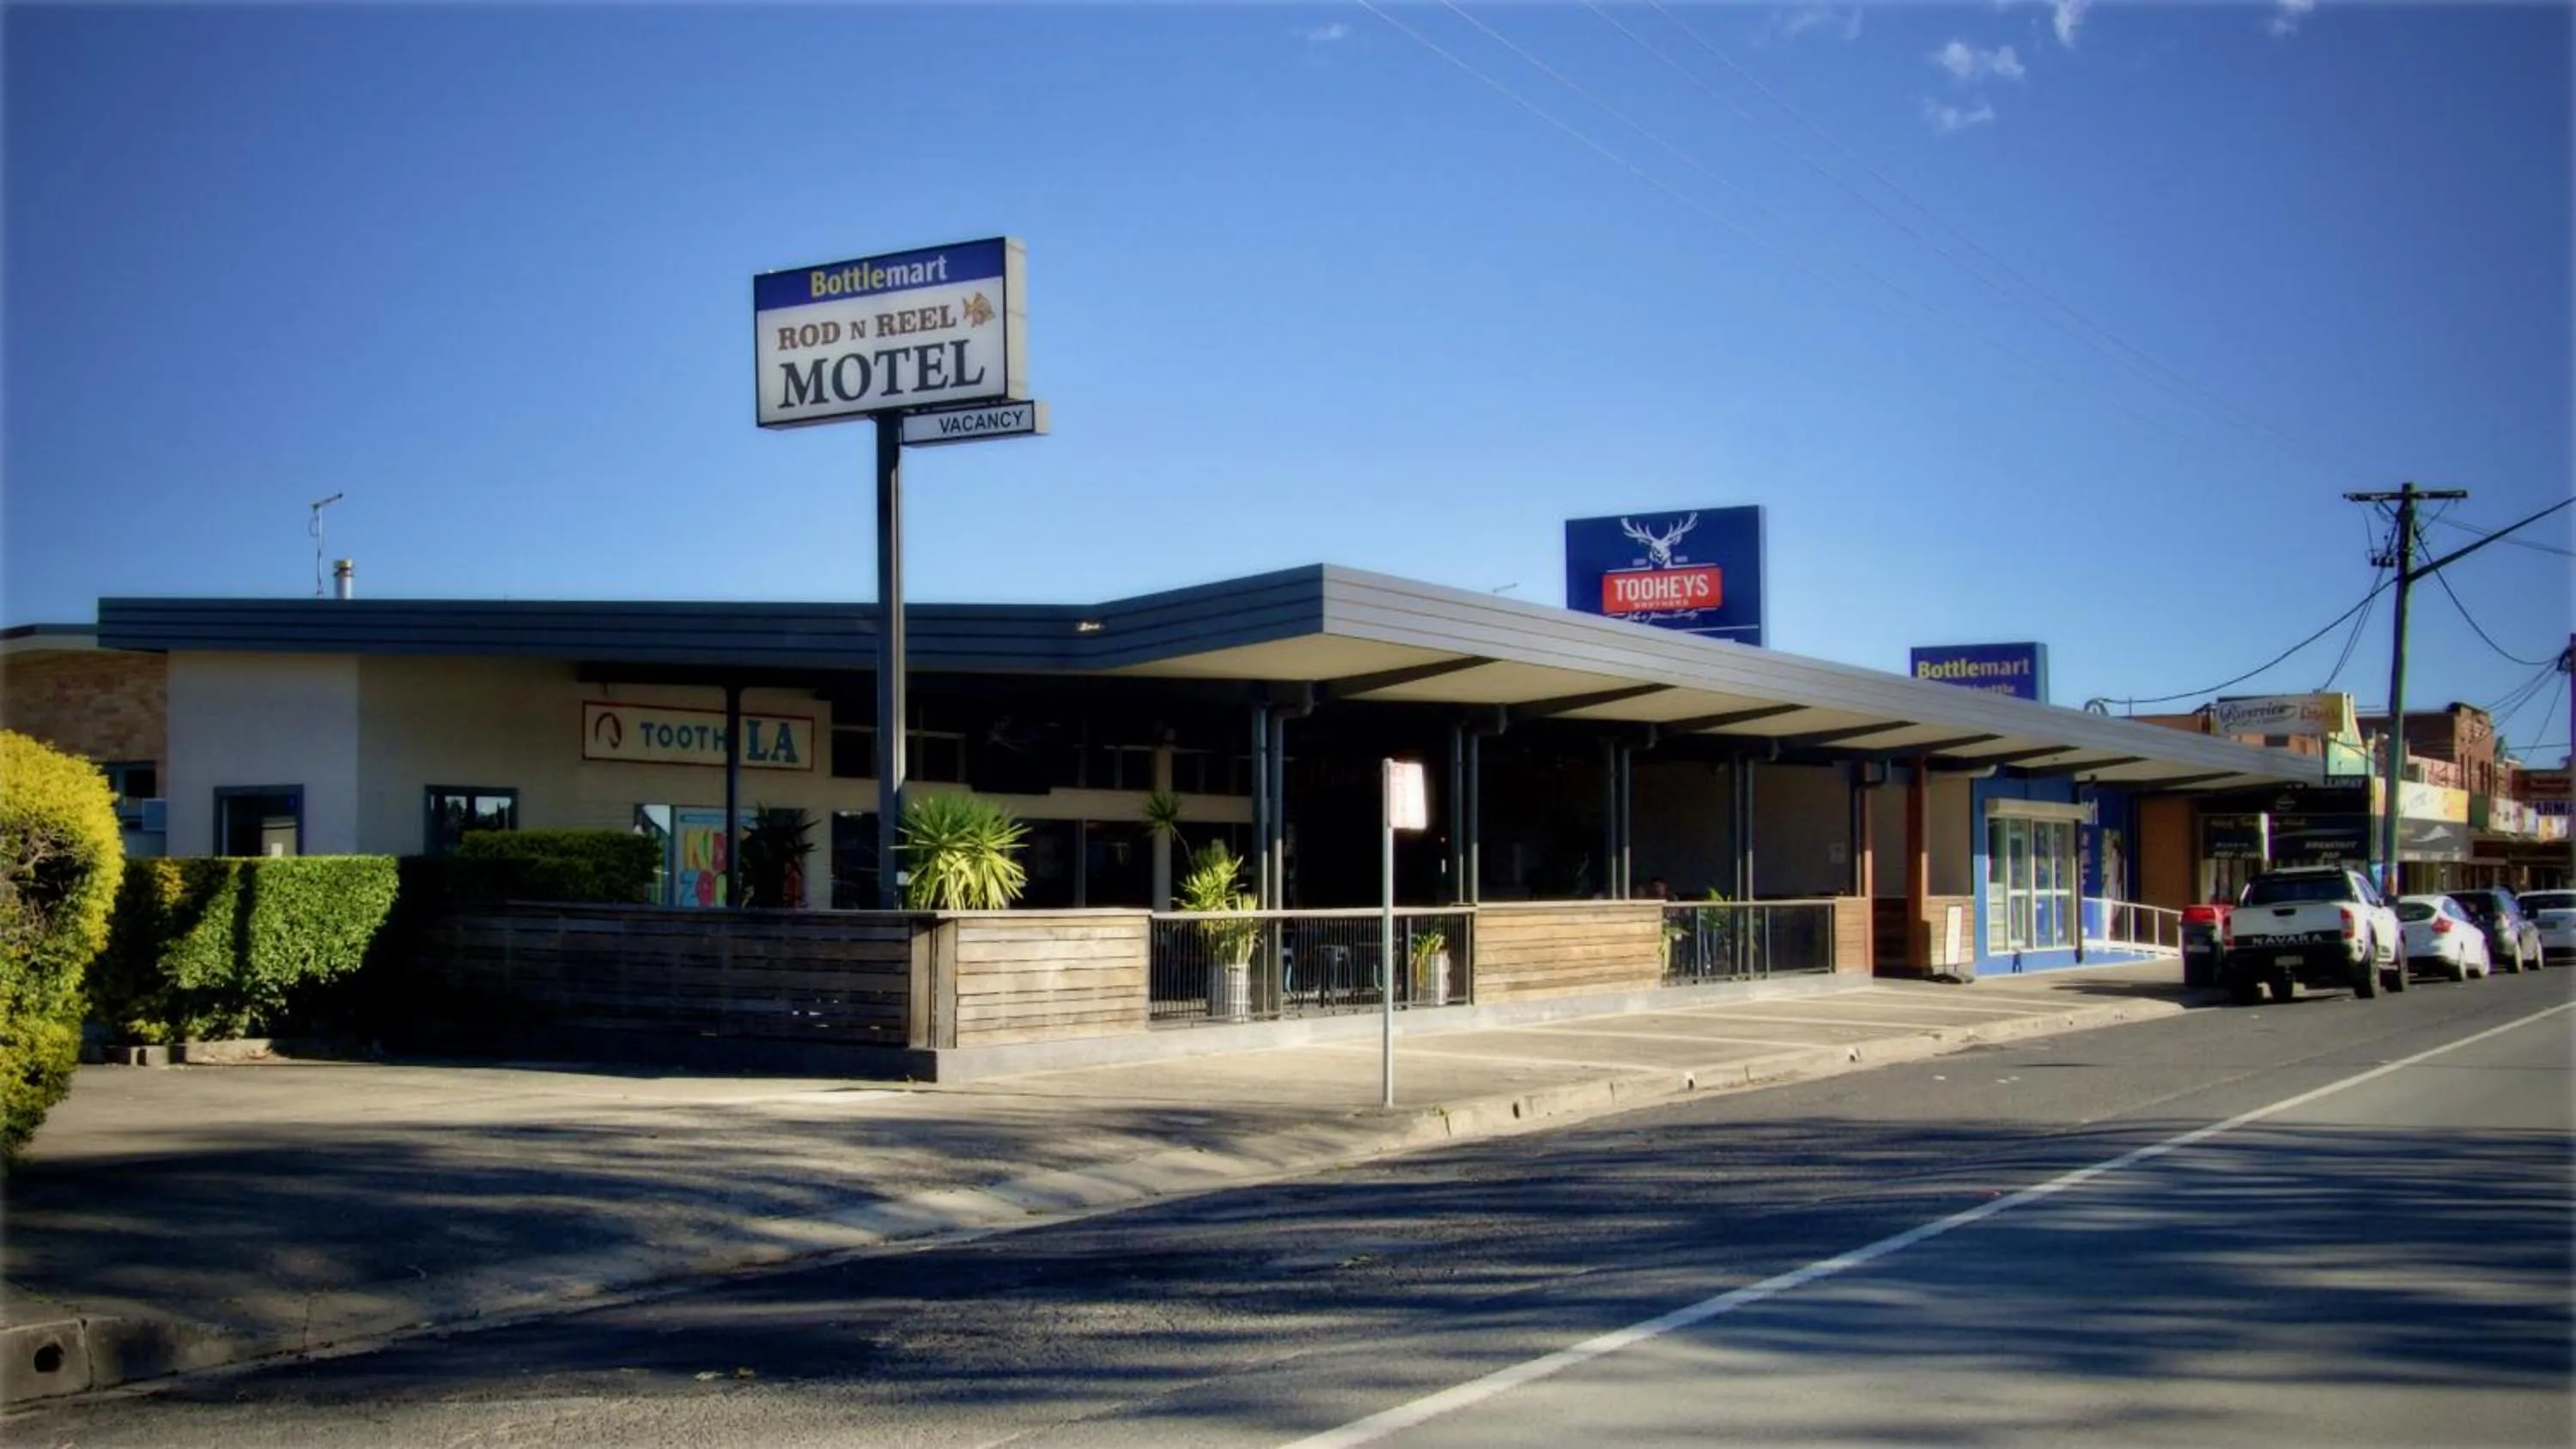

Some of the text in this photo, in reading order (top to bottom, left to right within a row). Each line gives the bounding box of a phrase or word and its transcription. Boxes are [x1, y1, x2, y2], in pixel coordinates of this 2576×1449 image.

[810, 255, 947, 298] Bottlemart
[777, 305, 957, 350] ROD N REEL
[777, 339, 985, 409] MOTEL
[939, 410, 1025, 433] VACANCY
[1614, 574, 1709, 602] TOOHEYS
[1917, 658, 2031, 679] Bottlemart
[746, 719, 799, 763] LA
